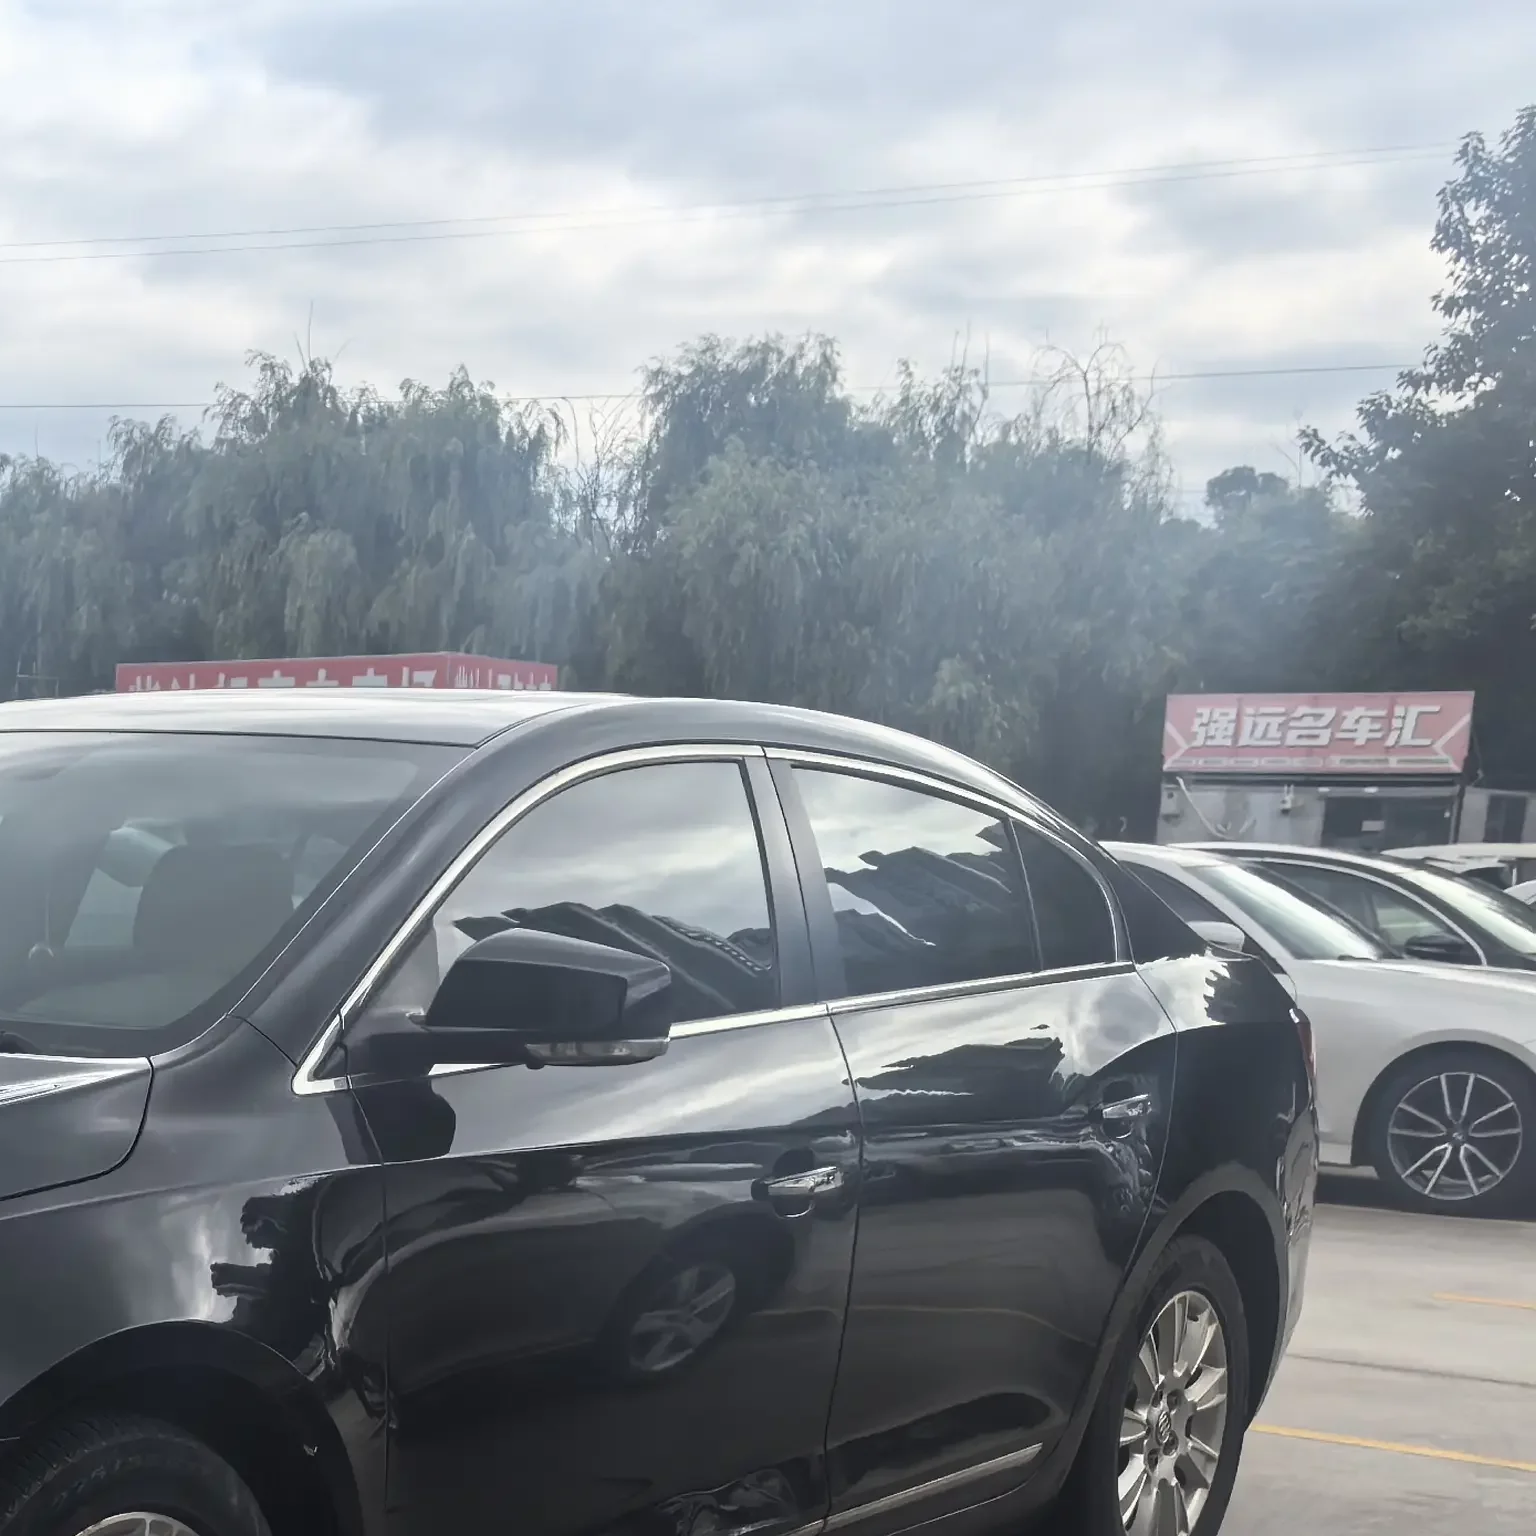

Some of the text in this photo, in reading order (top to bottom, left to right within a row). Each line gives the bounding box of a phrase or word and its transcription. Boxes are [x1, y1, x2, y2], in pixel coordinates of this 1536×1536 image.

[1191, 705, 1441, 749] 强远名车汇
